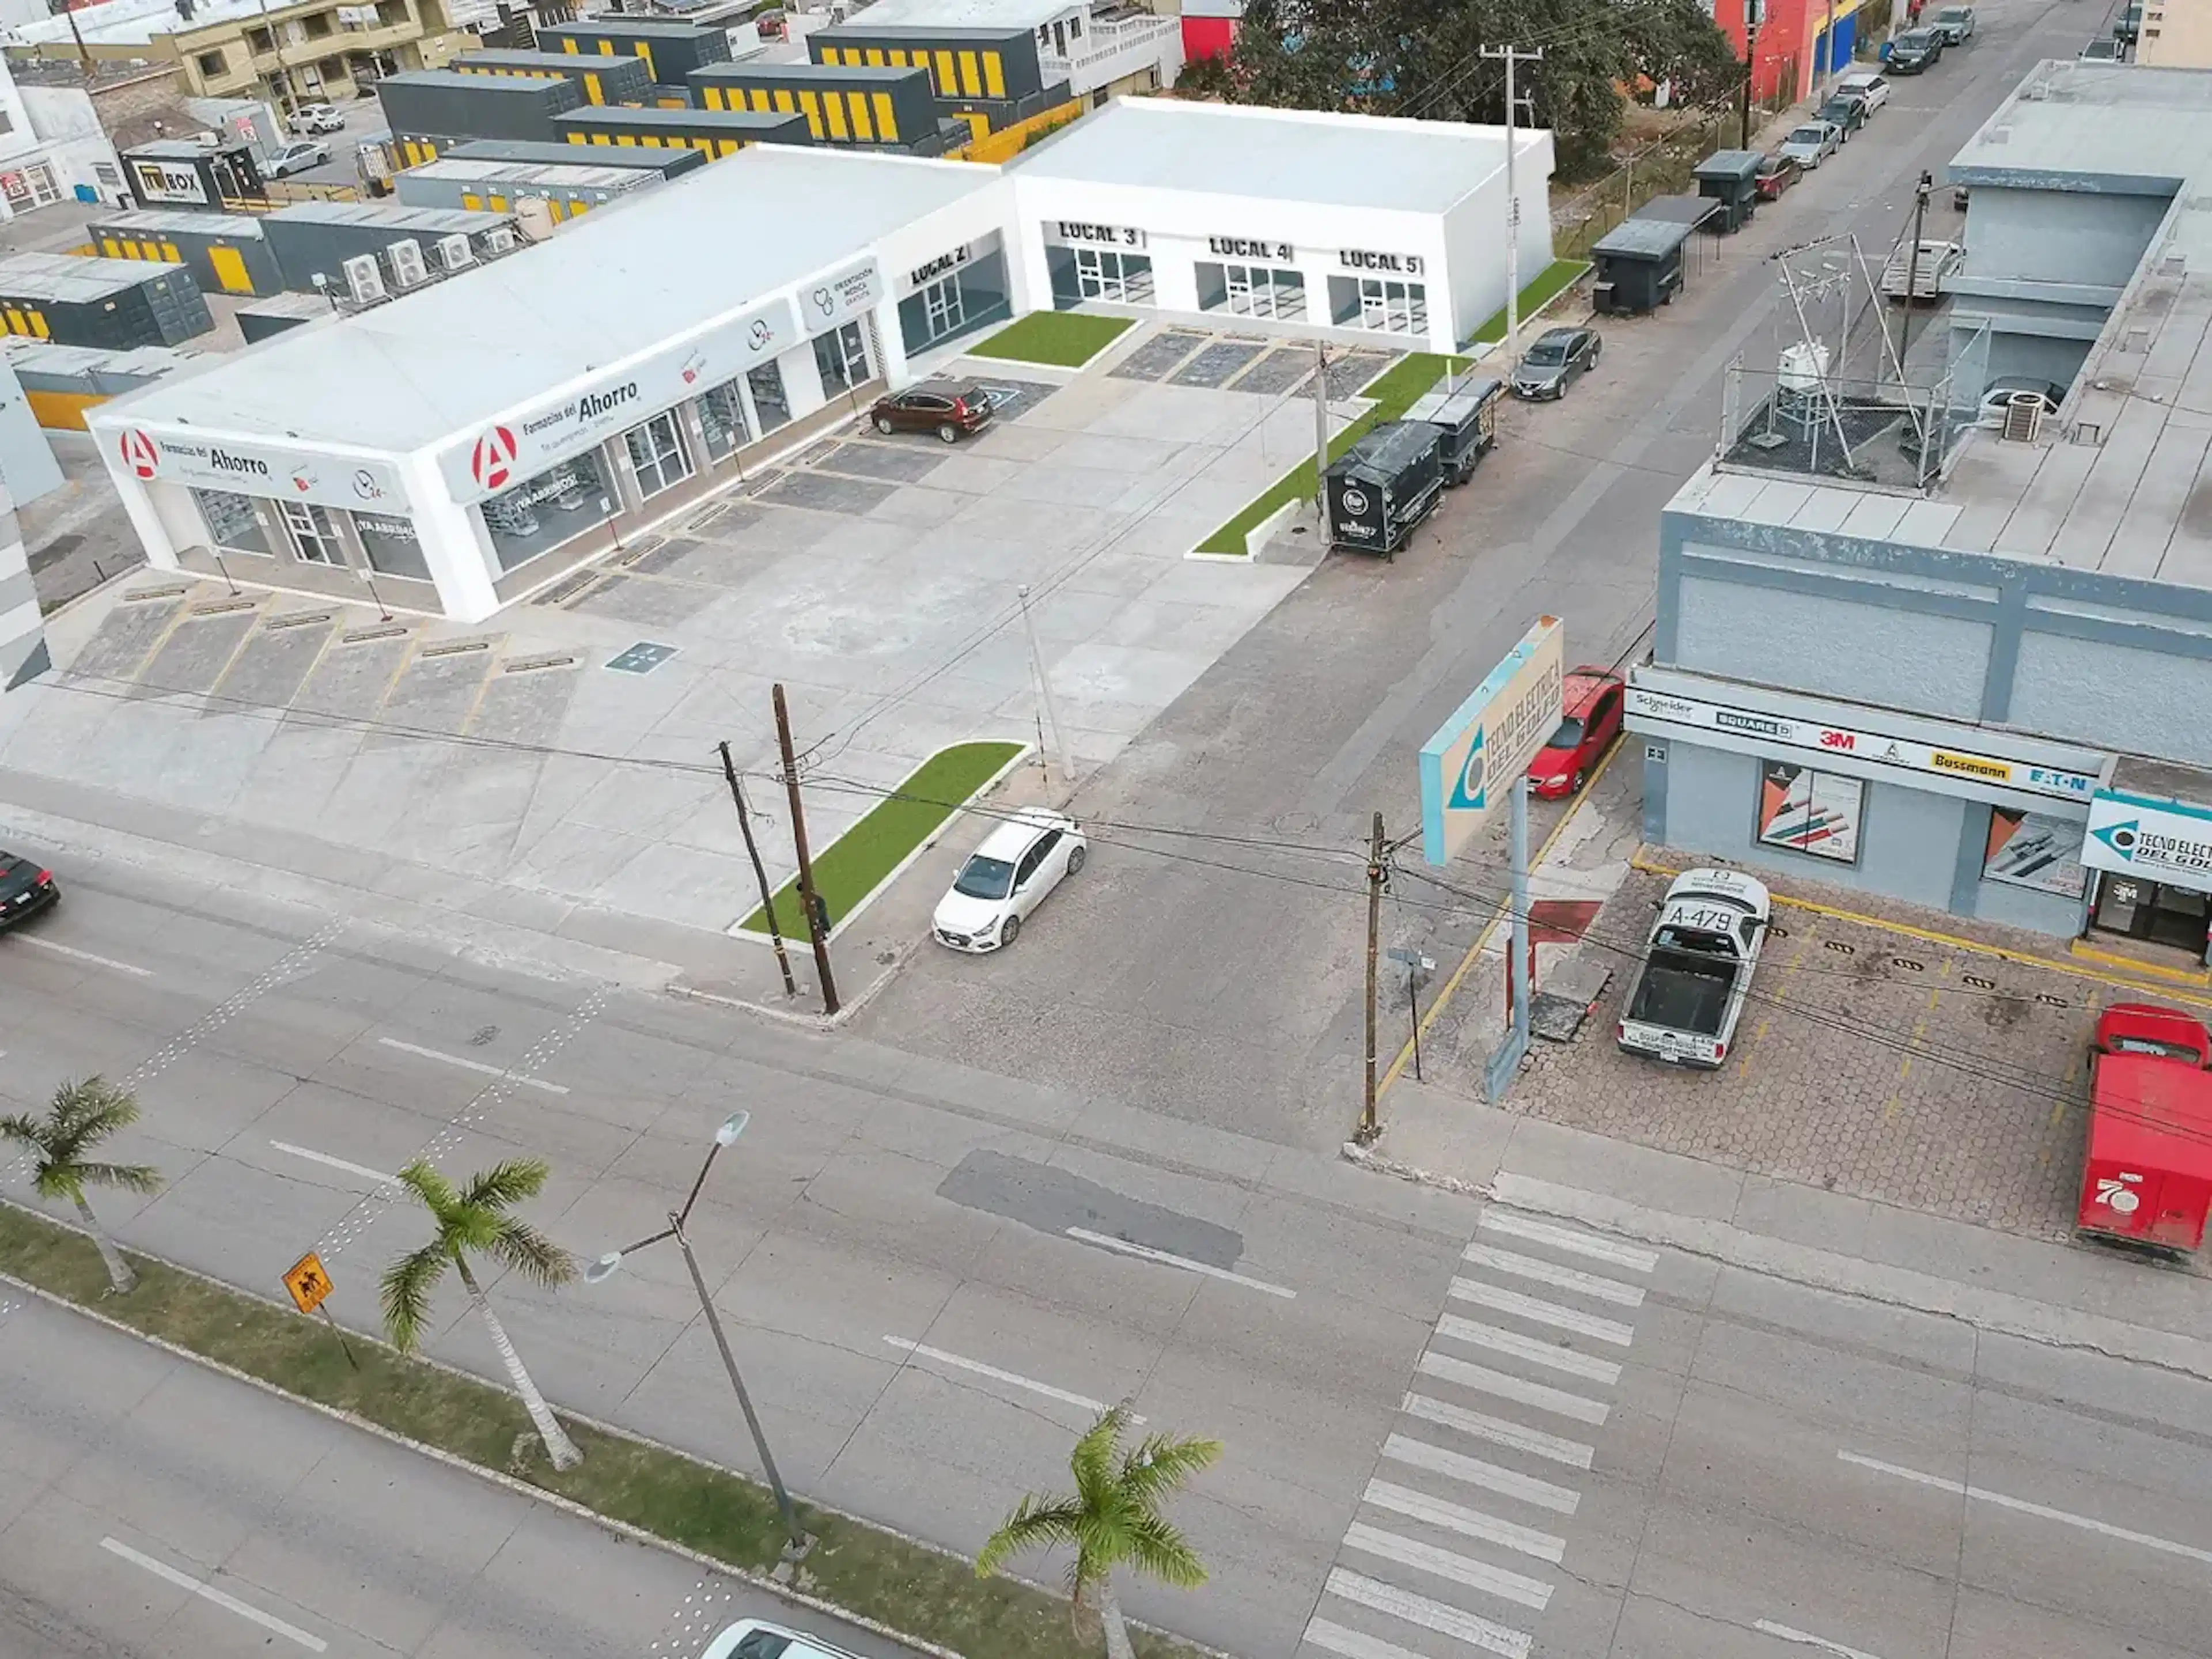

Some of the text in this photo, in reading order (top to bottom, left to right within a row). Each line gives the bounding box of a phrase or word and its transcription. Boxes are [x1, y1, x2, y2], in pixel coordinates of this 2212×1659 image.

[1123, 228, 1137, 245] 3
[1209, 237, 1289, 260] LOCAL 4
[1340, 251, 1417, 273] LOCAL 5
[578, 382, 637, 423] Ahorro
[211, 449, 268, 475] Ahorro
[1636, 694, 1694, 713] Schneider
[1487, 684, 1560, 781] DEL GOLFO
[1718, 715, 1776, 734] SQUARE
[1486, 711, 1514, 763] TECNO
[1820, 730, 1855, 750] 3M
[1935, 753, 2007, 779] Bussmann
[2139, 832, 2176, 850] TECNO
[2136, 847, 2168, 860] DEL
[1670, 907, 1732, 931] A-479
